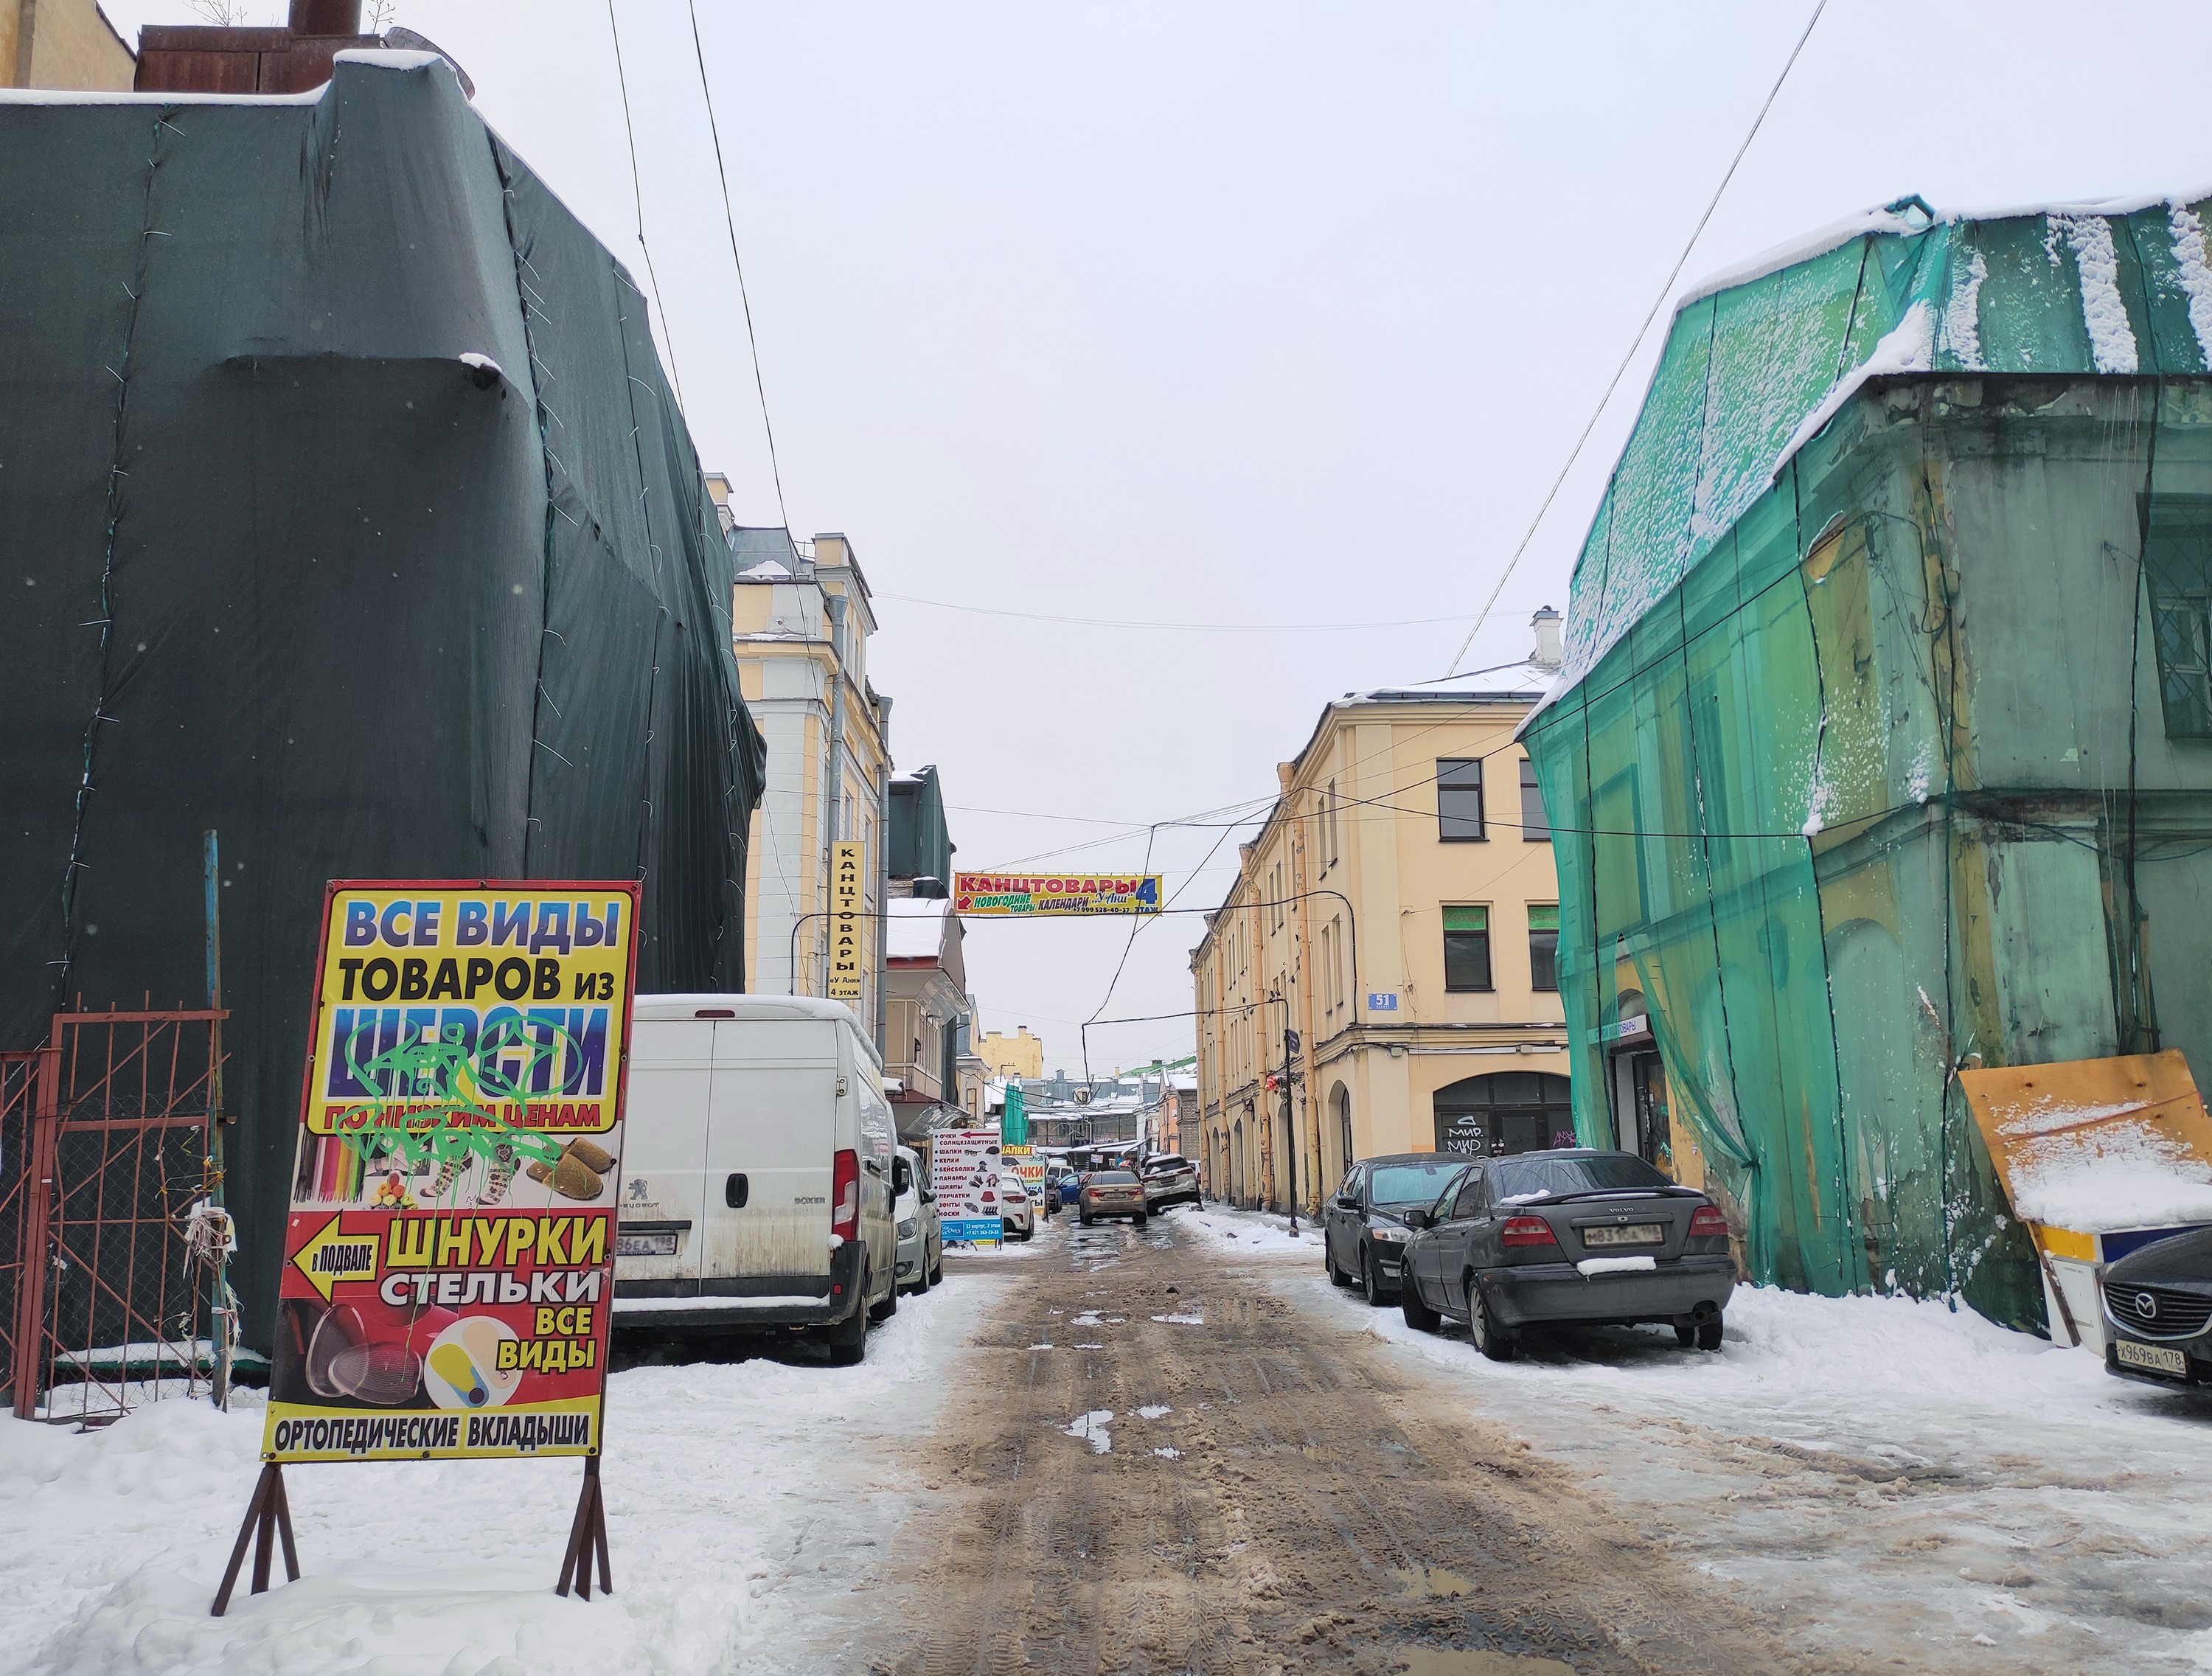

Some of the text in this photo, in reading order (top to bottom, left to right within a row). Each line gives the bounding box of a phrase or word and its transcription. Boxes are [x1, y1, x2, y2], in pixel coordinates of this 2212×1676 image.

[960, 877, 1137, 894] КАНЦТОВАРЫ
[973, 894, 1032, 908] НОВОГОДНИЕ
[1135, 878, 1158, 905] 4
[835, 849, 856, 971] КАНЦТОВАРЫ
[1010, 903, 1035, 913] ТОВАРЫ
[1038, 897, 1089, 911] КАЛЕНДАРИ
[344, 900, 622, 956] ВСЕ ВИДЫ
[338, 957, 561, 1001] ТОВАРОВ
[1376, 994, 1389, 1006] 51
[326, 1004, 611, 1099] ШЕРСТИ
[324, 1106, 367, 1130] ПО
[502, 1104, 601, 1130] ЦЕНАМ
[794, 1196, 826, 1204] BOXER
[387, 1216, 608, 1268] ШНУРКИ
[319, 1245, 373, 1276] ПОДВАЛЕ
[380, 1270, 602, 1306] СТЕЛЬКИ
[534, 1306, 593, 1337] ВСЕ
[497, 1341, 595, 1374] ВИДЫ
[2163, 1351, 2182, 1365] 178
[274, 1414, 589, 1454] ОРТОПЕДИЧЕСКИЕ ВКЛАДЫШИ
